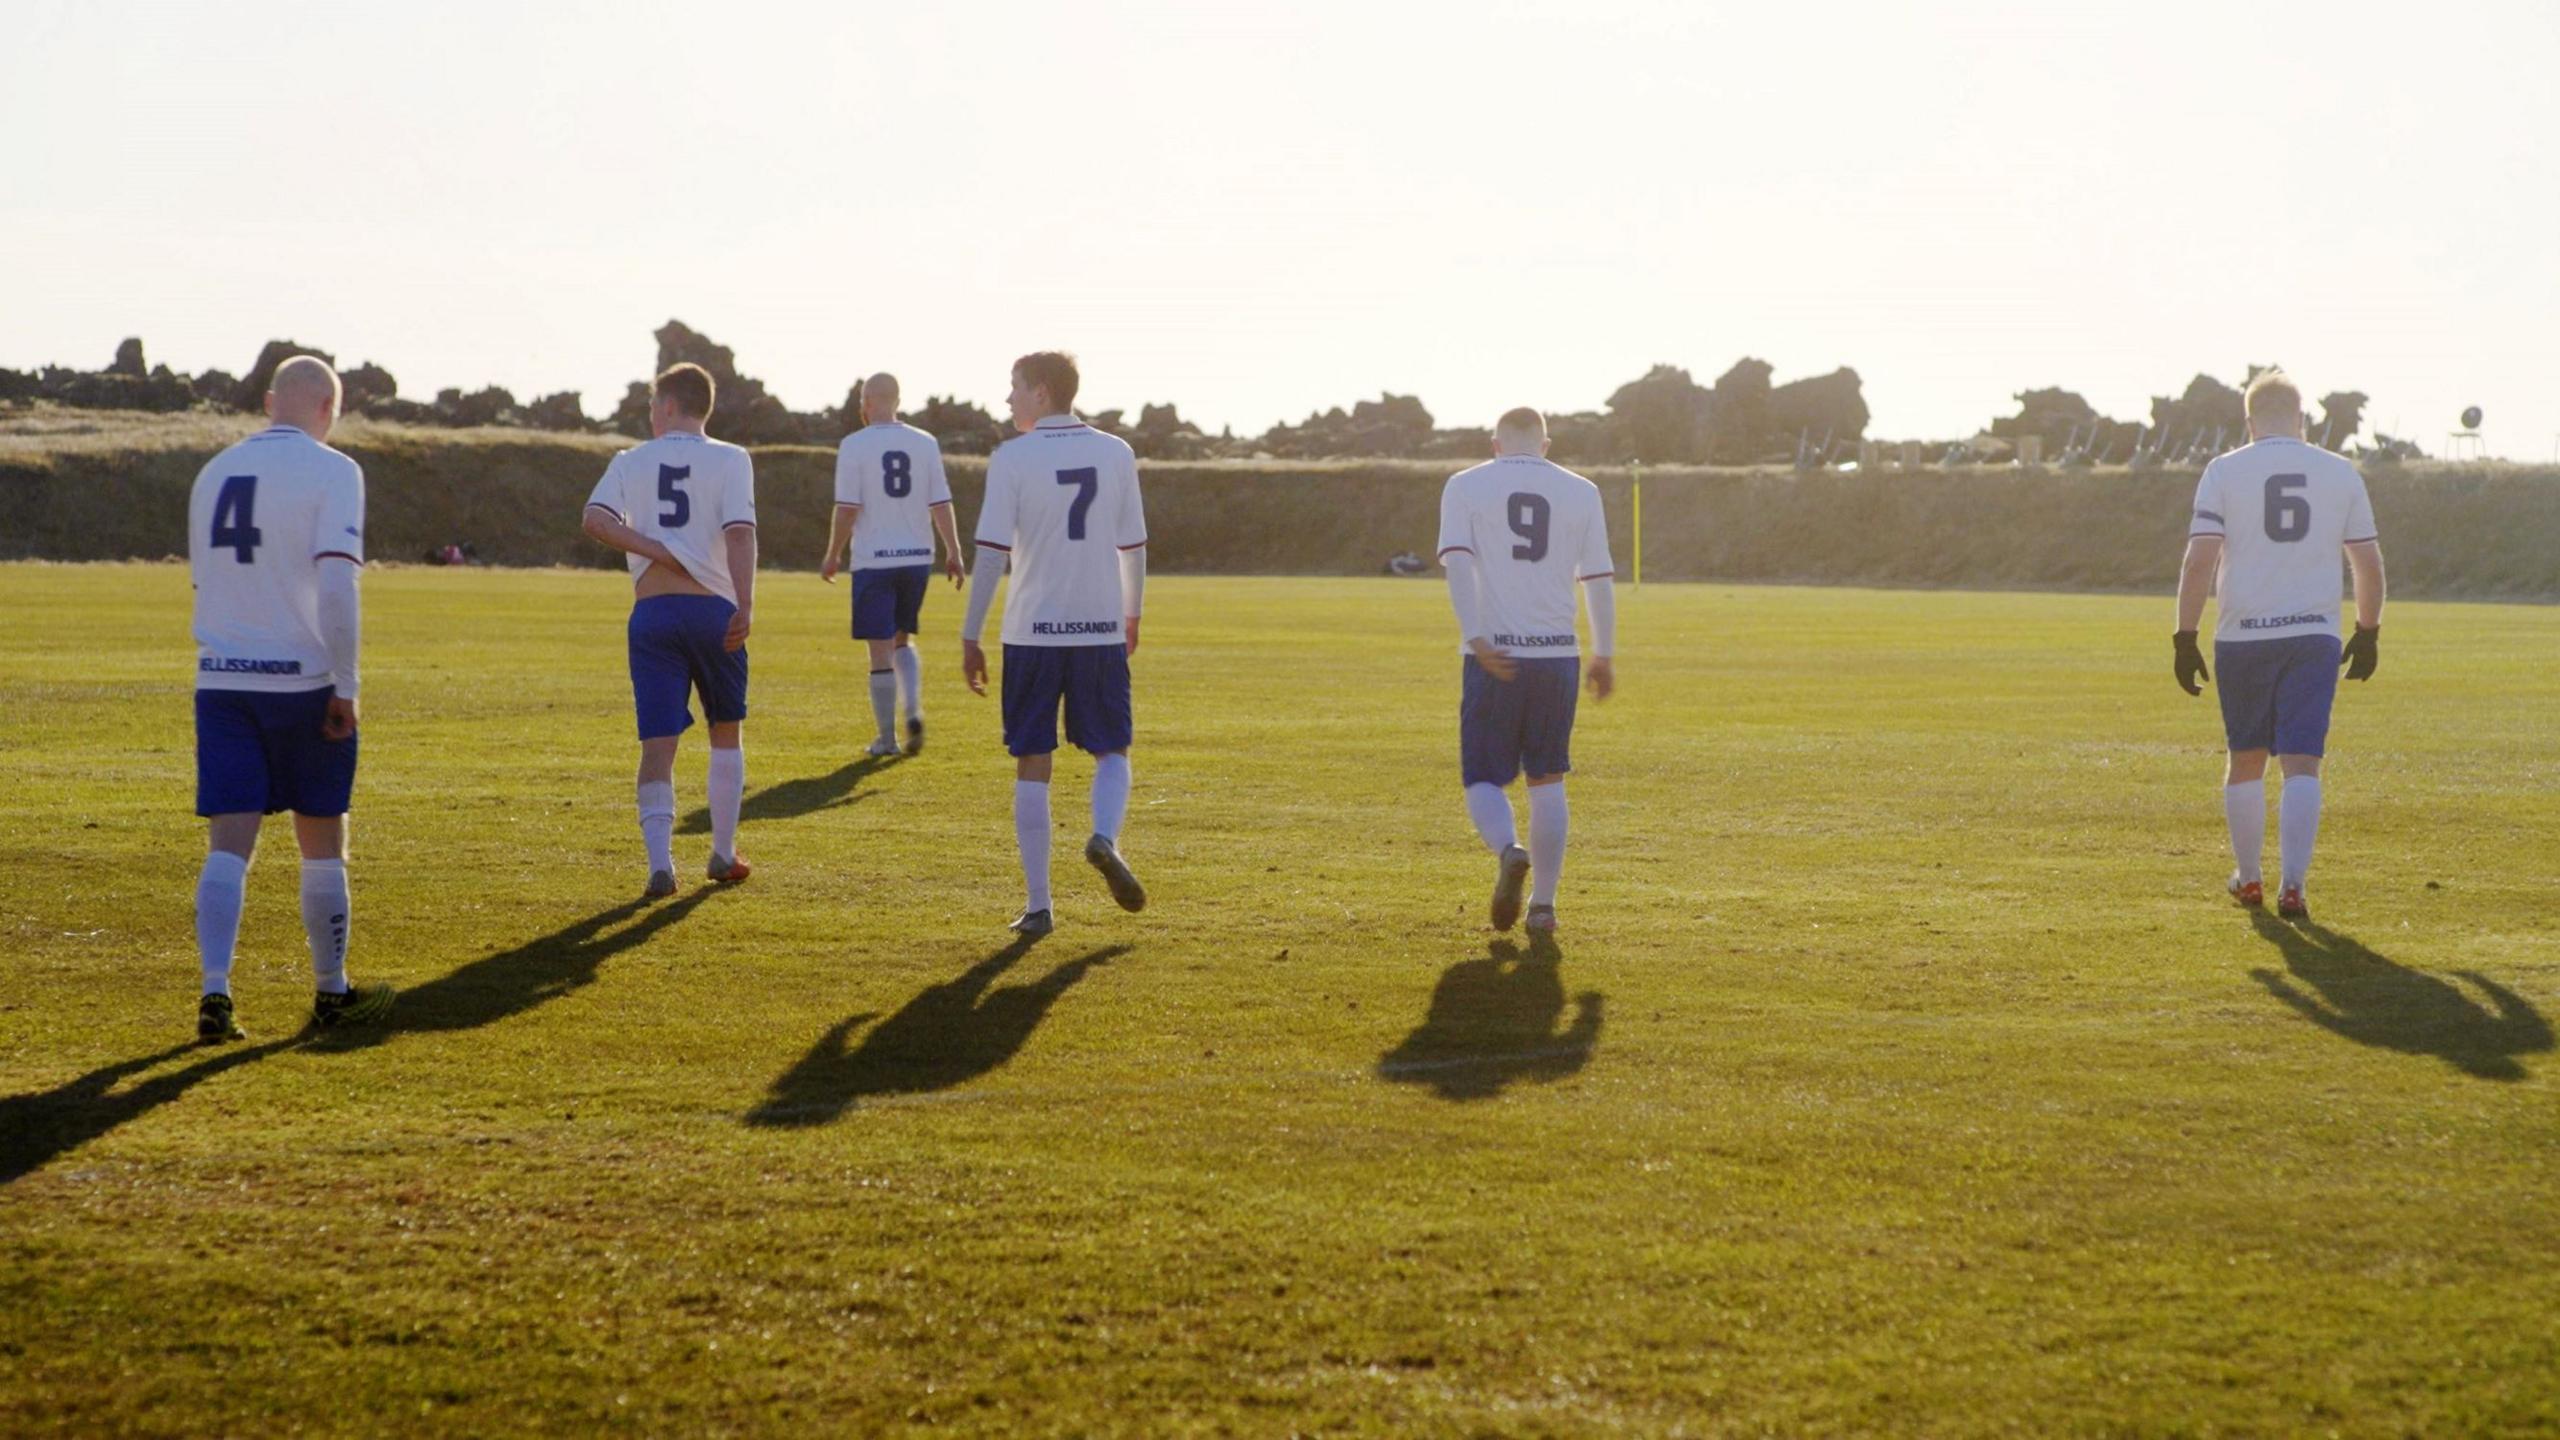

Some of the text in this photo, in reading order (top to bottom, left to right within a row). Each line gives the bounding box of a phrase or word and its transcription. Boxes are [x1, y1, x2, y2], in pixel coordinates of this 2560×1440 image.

[658, 464, 691, 528] 5
[882, 451, 912, 498] 8
[1055, 467, 1098, 540] 7
[2263, 474, 2311, 543] 6
[211, 475, 262, 564] 4
[1506, 492, 1551, 563] 9
[200, 657, 302, 675] ELLISSANDUR
